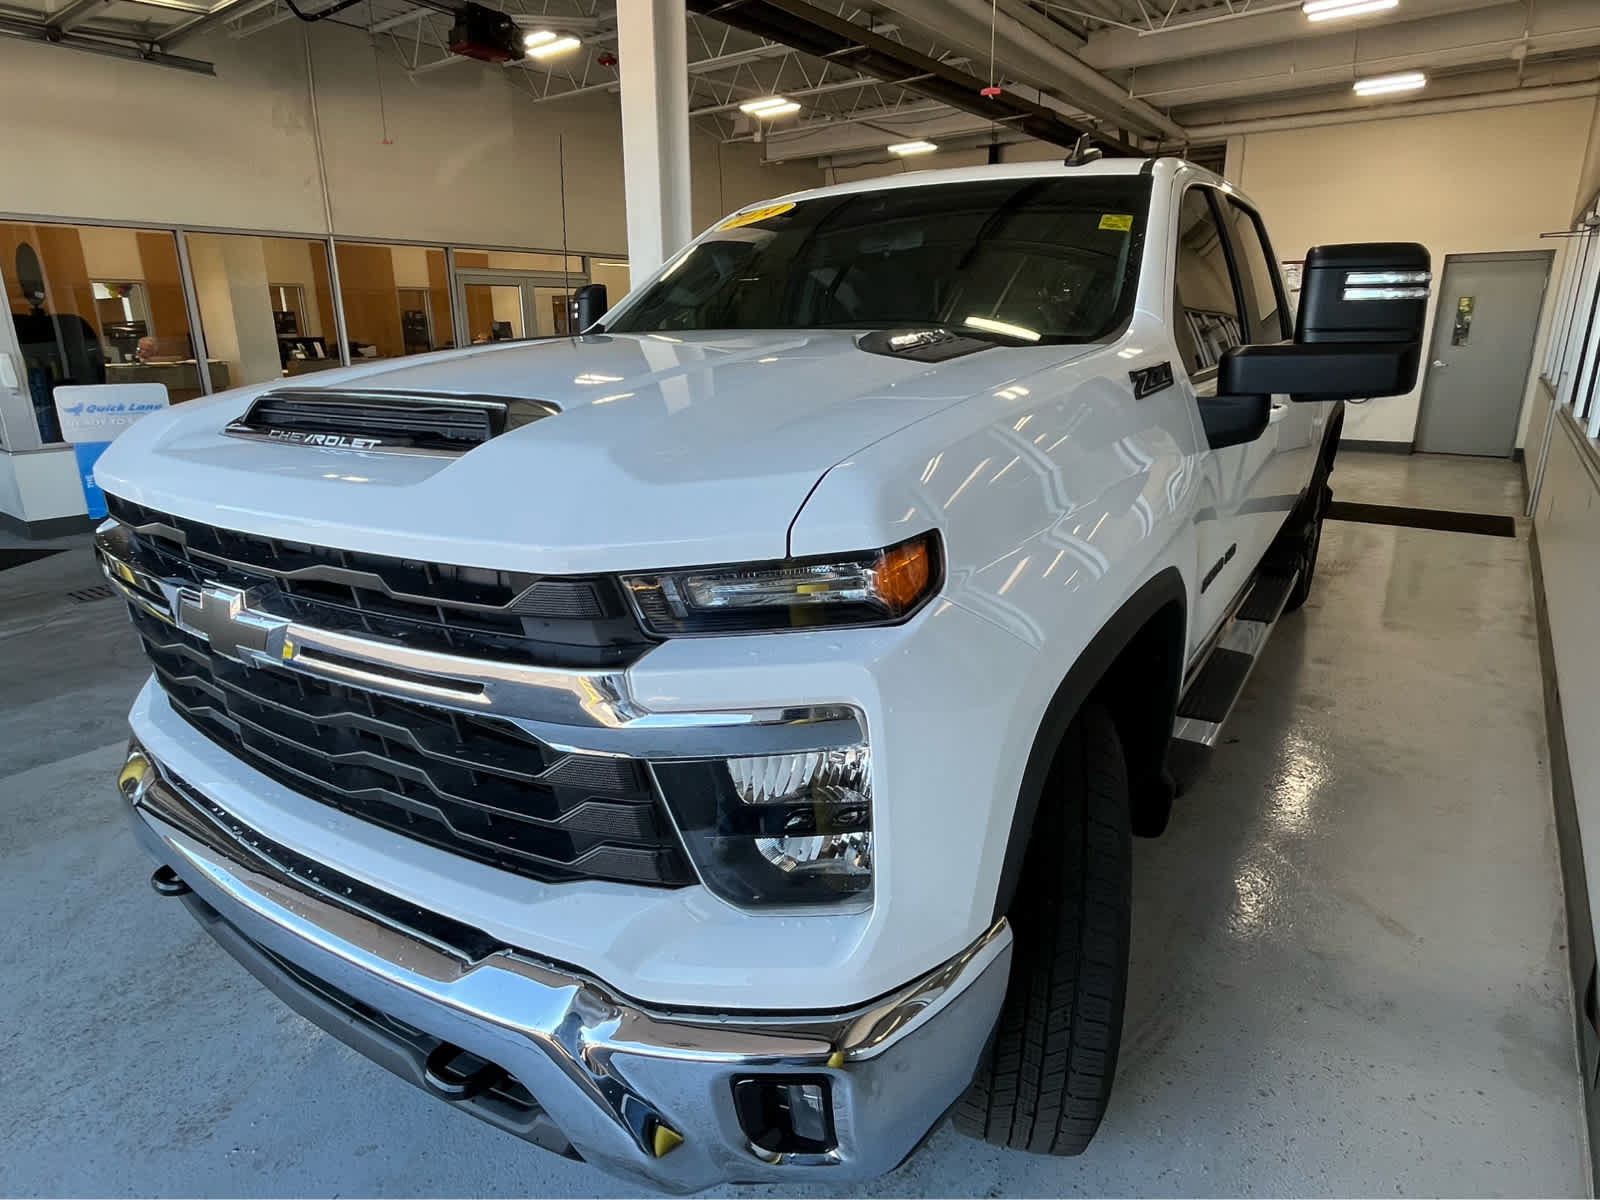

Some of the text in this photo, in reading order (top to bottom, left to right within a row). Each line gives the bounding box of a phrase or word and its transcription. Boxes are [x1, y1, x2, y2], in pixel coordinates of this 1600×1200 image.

[86, 402, 163, 414] Quick Lane
[268, 429, 382, 450] CHEVROLET
